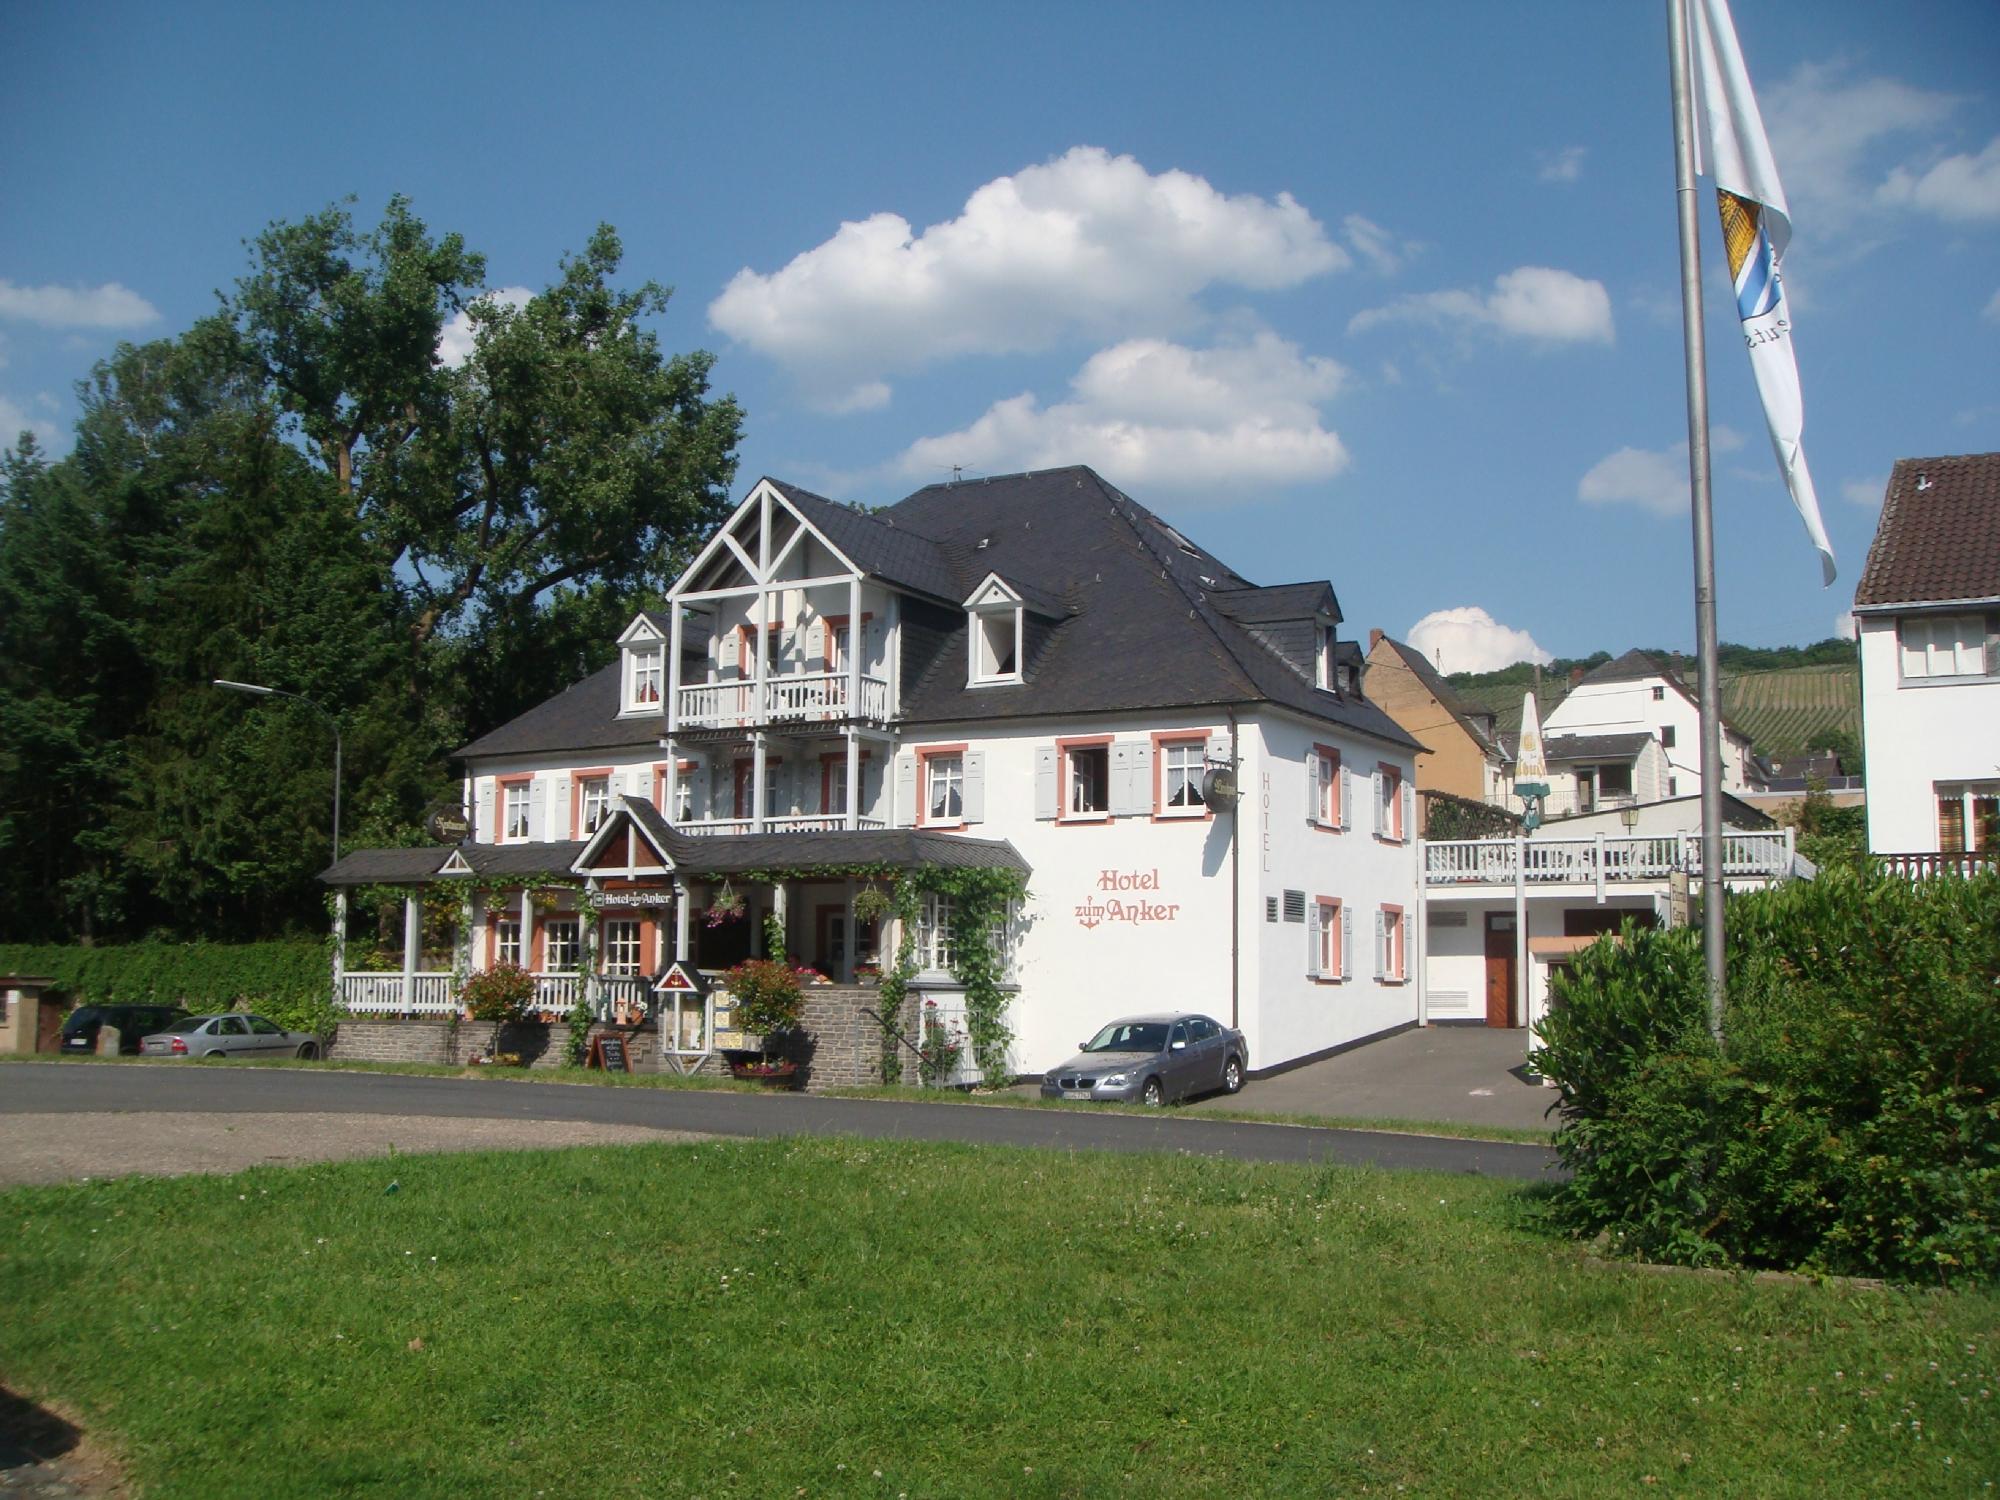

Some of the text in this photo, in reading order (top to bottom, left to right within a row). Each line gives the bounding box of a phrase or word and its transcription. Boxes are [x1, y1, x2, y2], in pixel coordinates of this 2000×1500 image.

[1263, 772, 1271, 872] HOTEL
[1097, 869, 1160, 891] Hotel
[605, 893, 629, 905] Hotel
[641, 893, 671, 906] Anker
[1075, 899, 1180, 926] zum Anker
